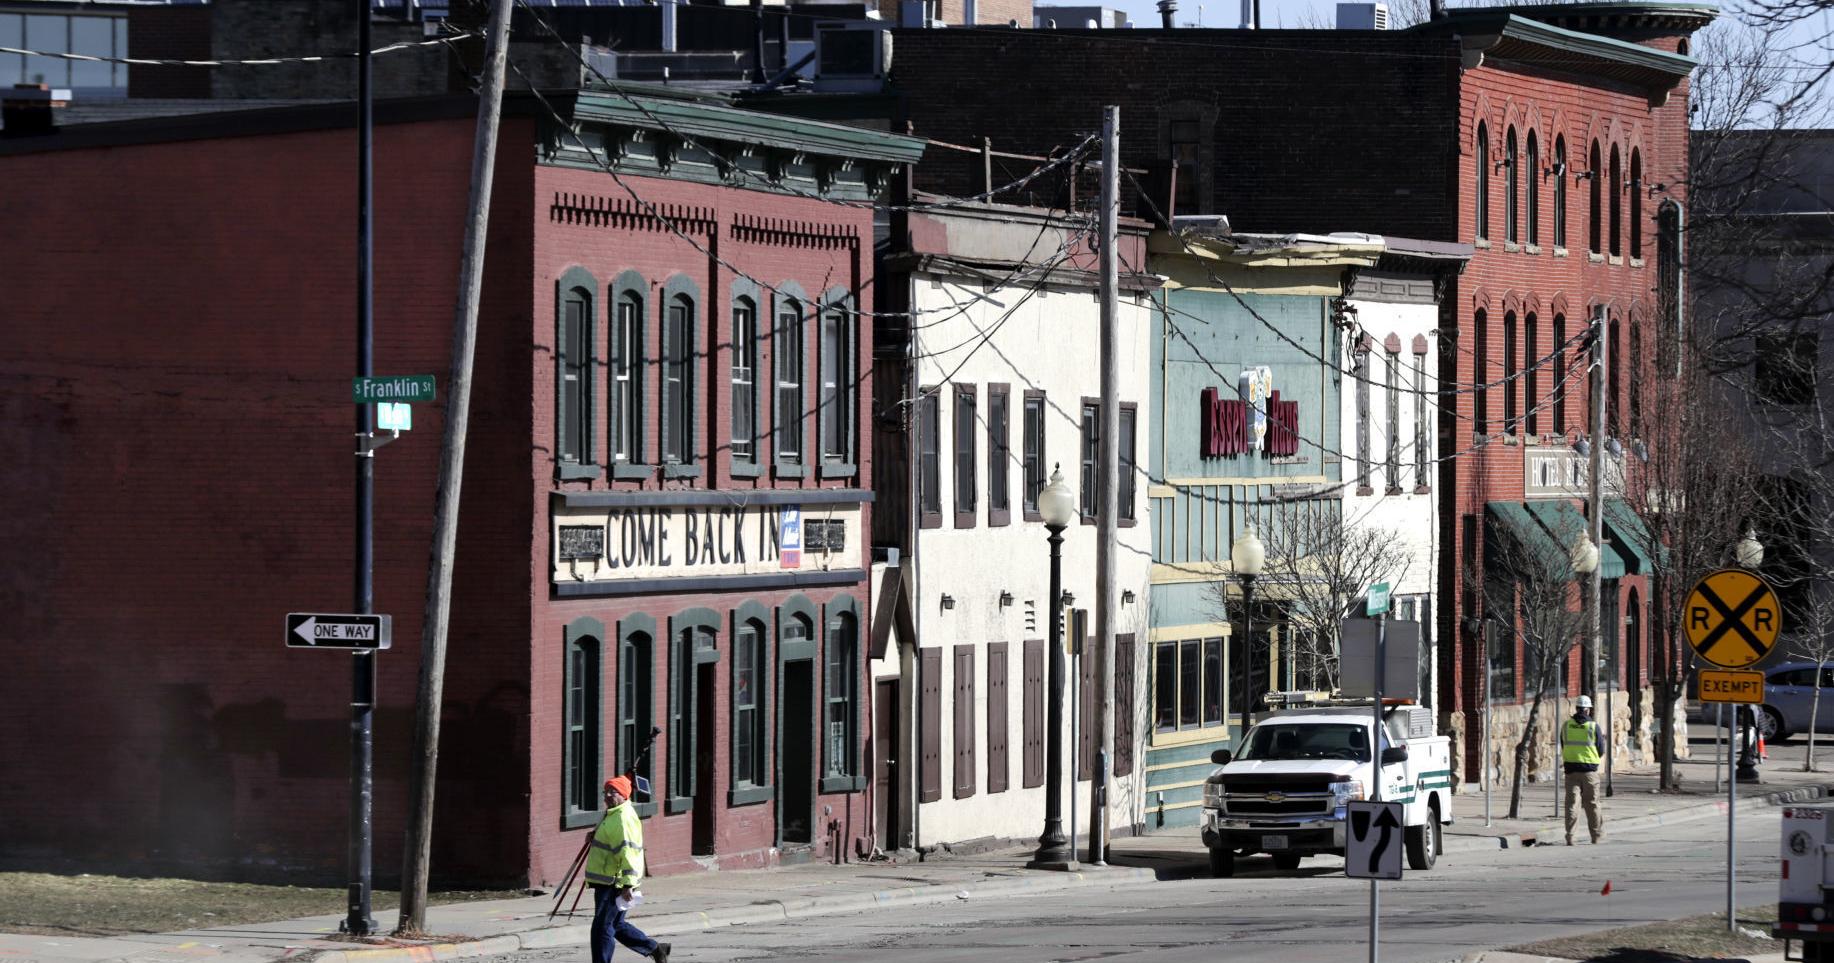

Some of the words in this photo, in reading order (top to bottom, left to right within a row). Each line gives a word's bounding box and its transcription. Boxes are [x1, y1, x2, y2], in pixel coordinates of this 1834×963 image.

[355, 384, 361, 394] S
[363, 379, 419, 398] Franklin
[423, 381, 431, 392] St
[1531, 457, 1561, 487] HOTEL
[606, 507, 672, 569] COME
[685, 506, 746, 566] BACK
[759, 505, 780, 562] IN
[1691, 606, 1710, 630] R
[1754, 608, 1773, 631] R
[313, 624, 339, 638] ONE
[344, 625, 372, 638] WAY
[1703, 680, 1760, 694] EXEMPT
